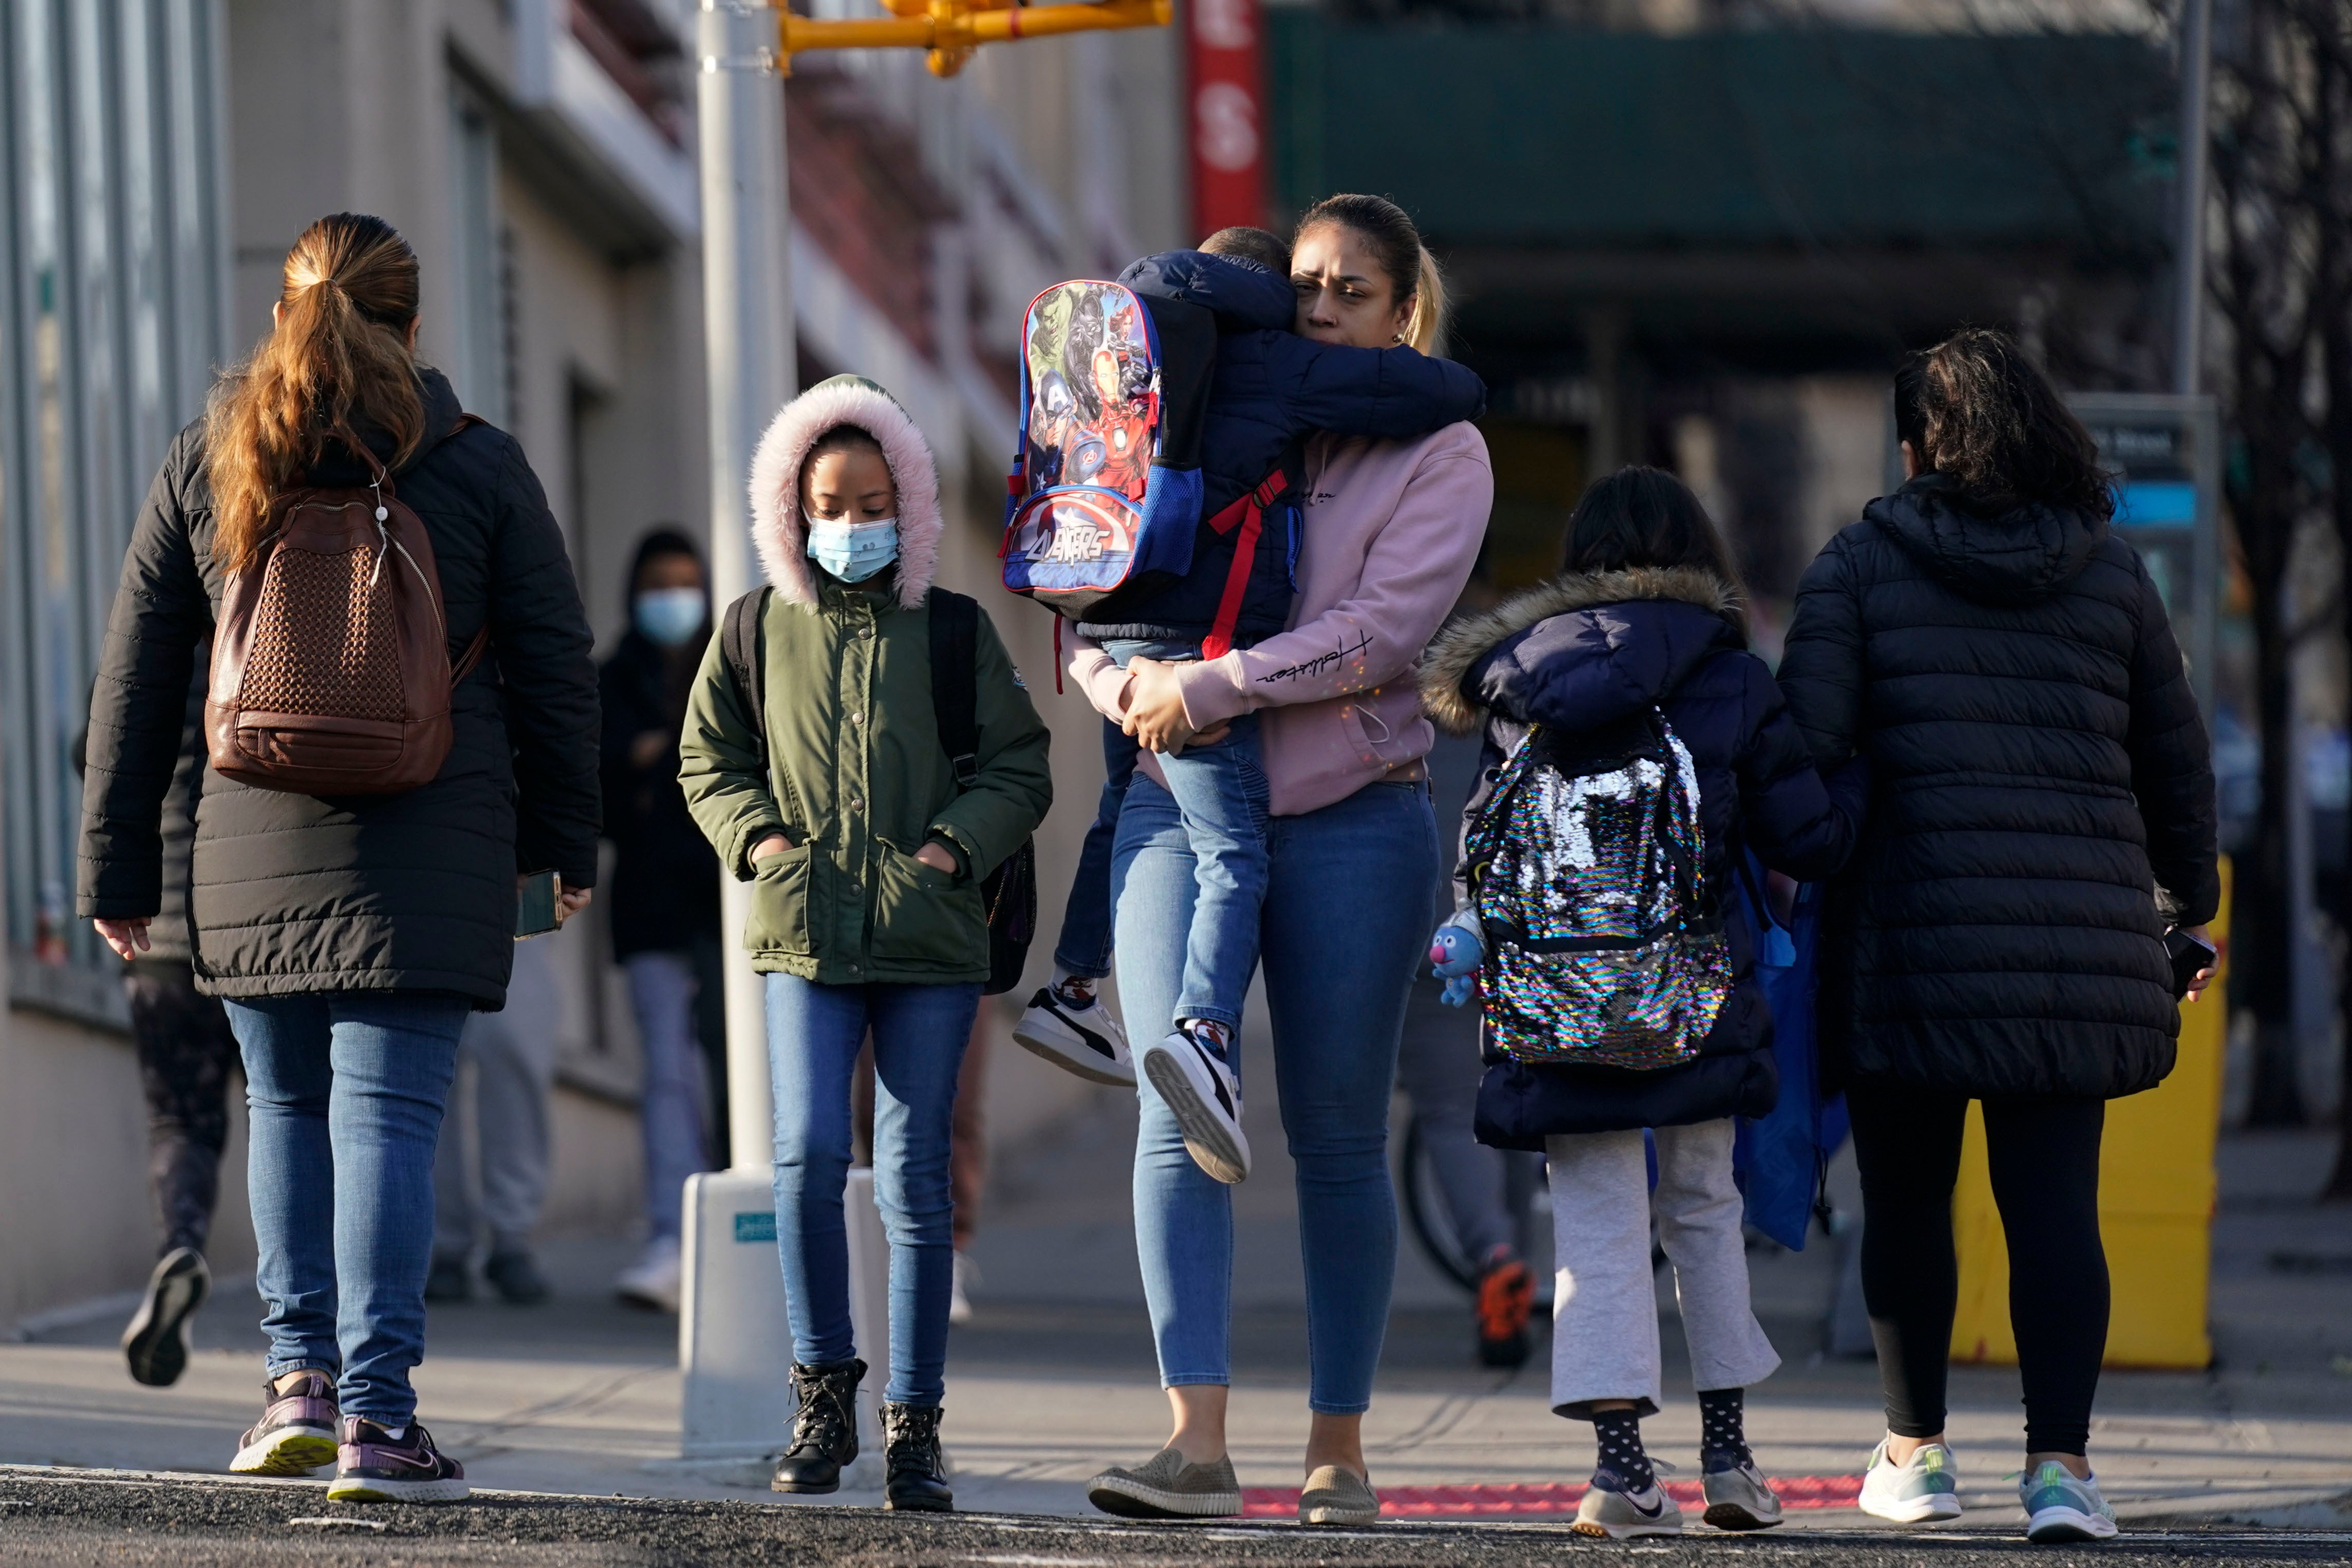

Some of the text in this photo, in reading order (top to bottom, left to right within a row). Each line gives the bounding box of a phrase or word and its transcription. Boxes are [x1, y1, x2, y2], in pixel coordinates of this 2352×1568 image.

[1047, 384, 1067, 410] A
[1025, 526, 1110, 566] AVENGERS
[1256, 629, 1373, 683] Hollister
